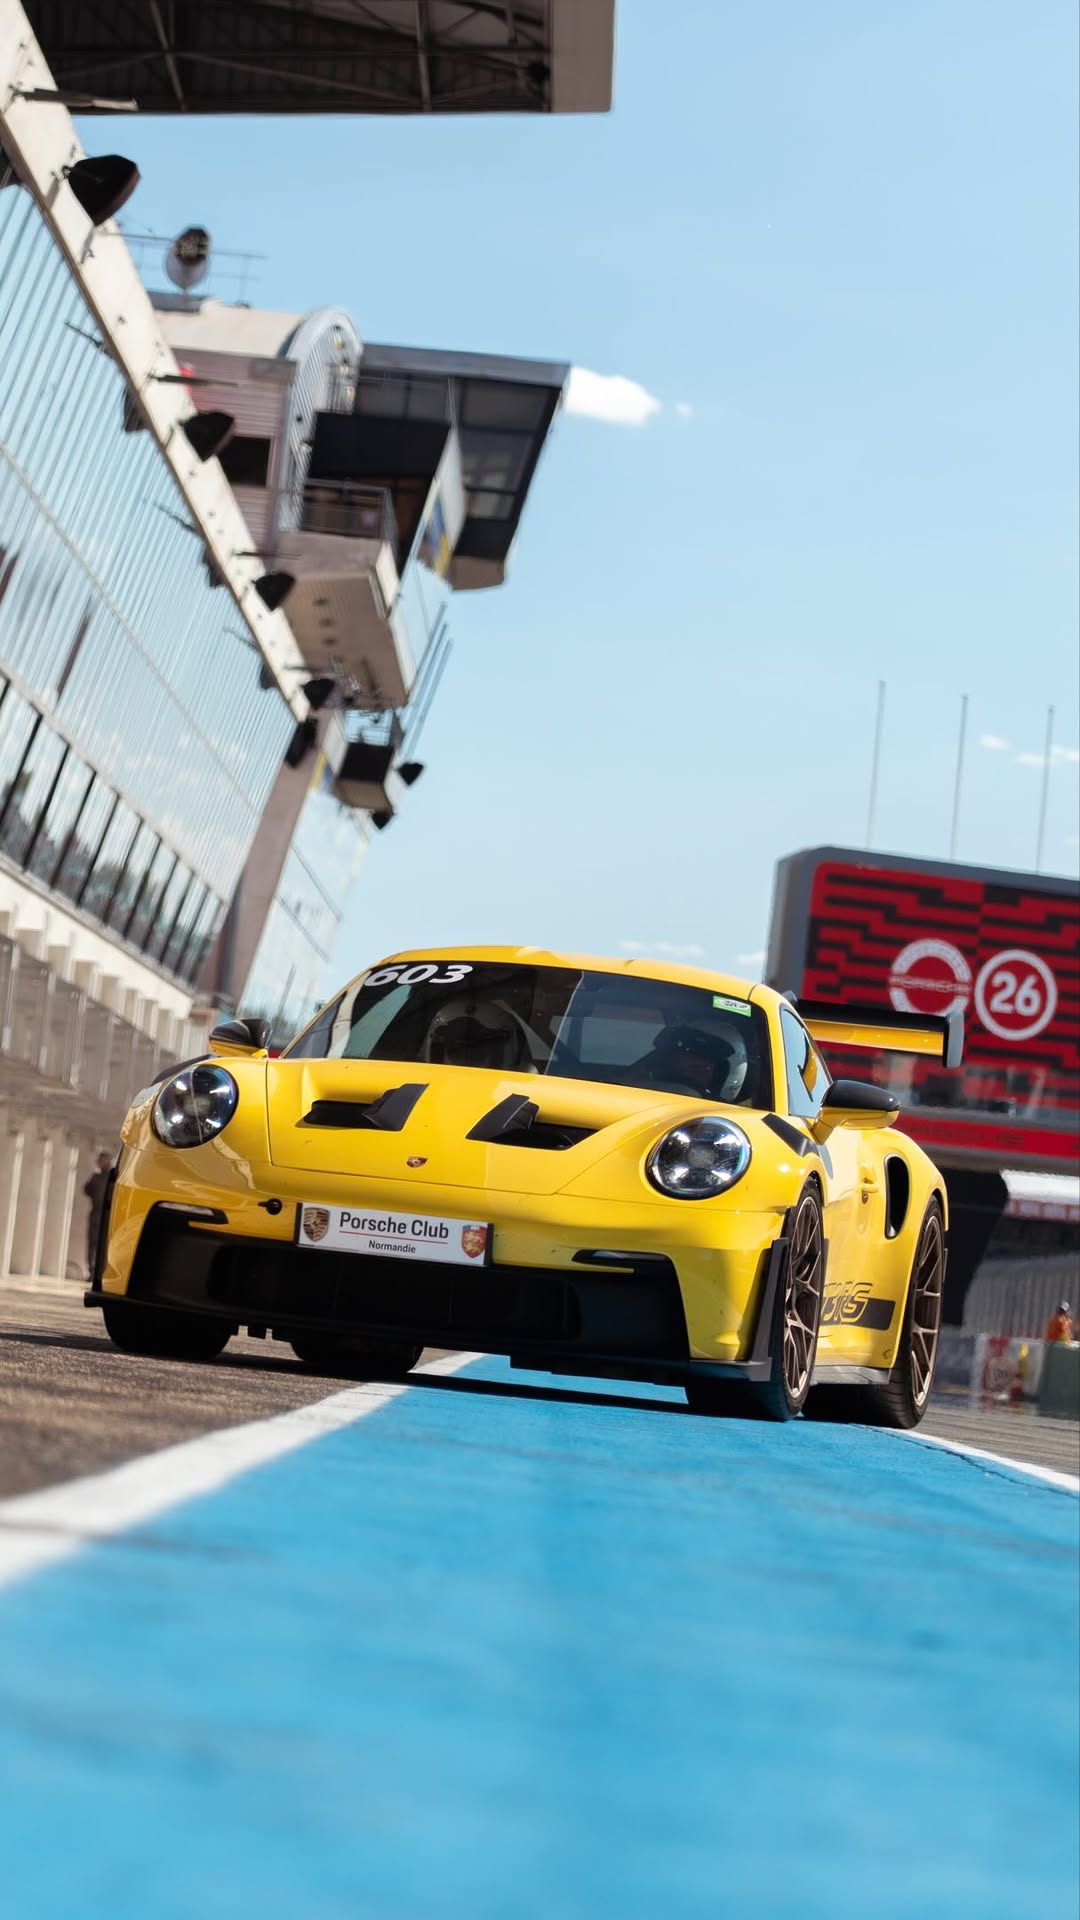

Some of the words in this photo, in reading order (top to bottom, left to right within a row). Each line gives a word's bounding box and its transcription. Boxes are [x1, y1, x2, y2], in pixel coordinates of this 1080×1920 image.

[363, 964, 473, 987] 603
[991, 970, 1041, 1016] 26
[339, 1211, 407, 1235] Porsche
[411, 1219, 449, 1239] Club
[368, 1240, 416, 1254] Normandie
